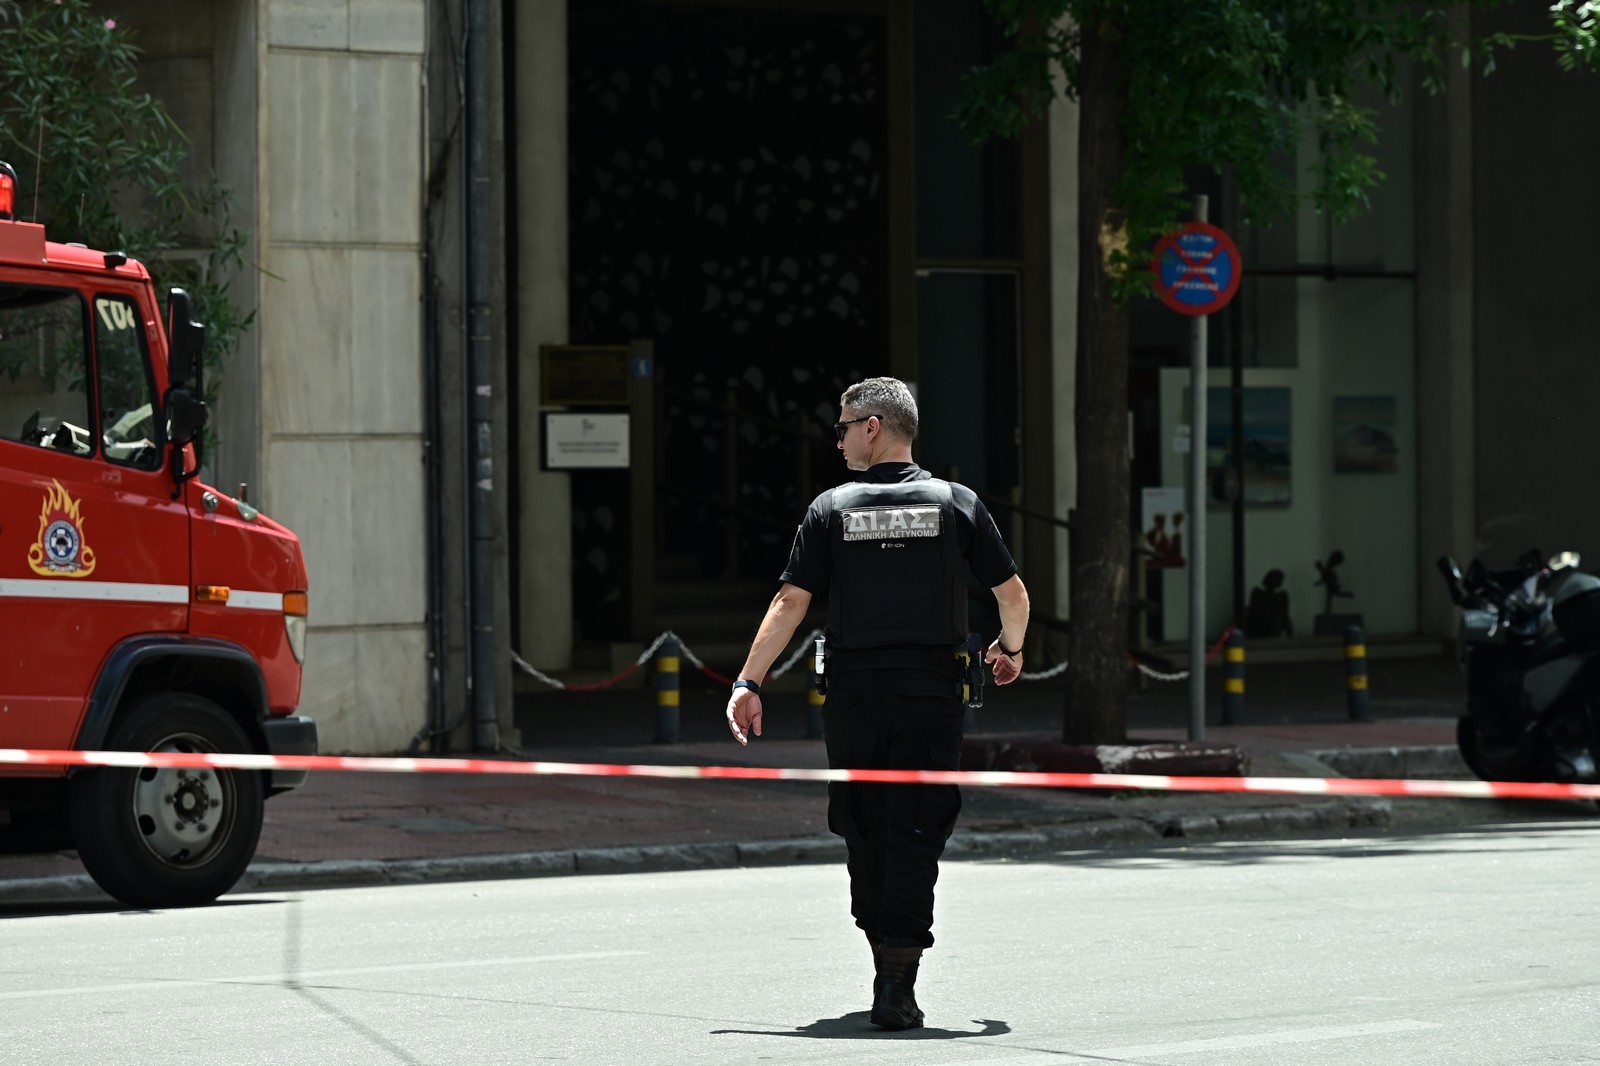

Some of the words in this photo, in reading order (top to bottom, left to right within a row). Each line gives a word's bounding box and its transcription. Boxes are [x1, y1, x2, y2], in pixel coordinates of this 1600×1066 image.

[848, 509, 935, 532] ΔΙ.ΑΣ.
[844, 531, 887, 541] ΕΛΛΗΝΙΚΗ
[889, 529, 938, 539] ΑΣΤΥΝΟΜΙΑ
